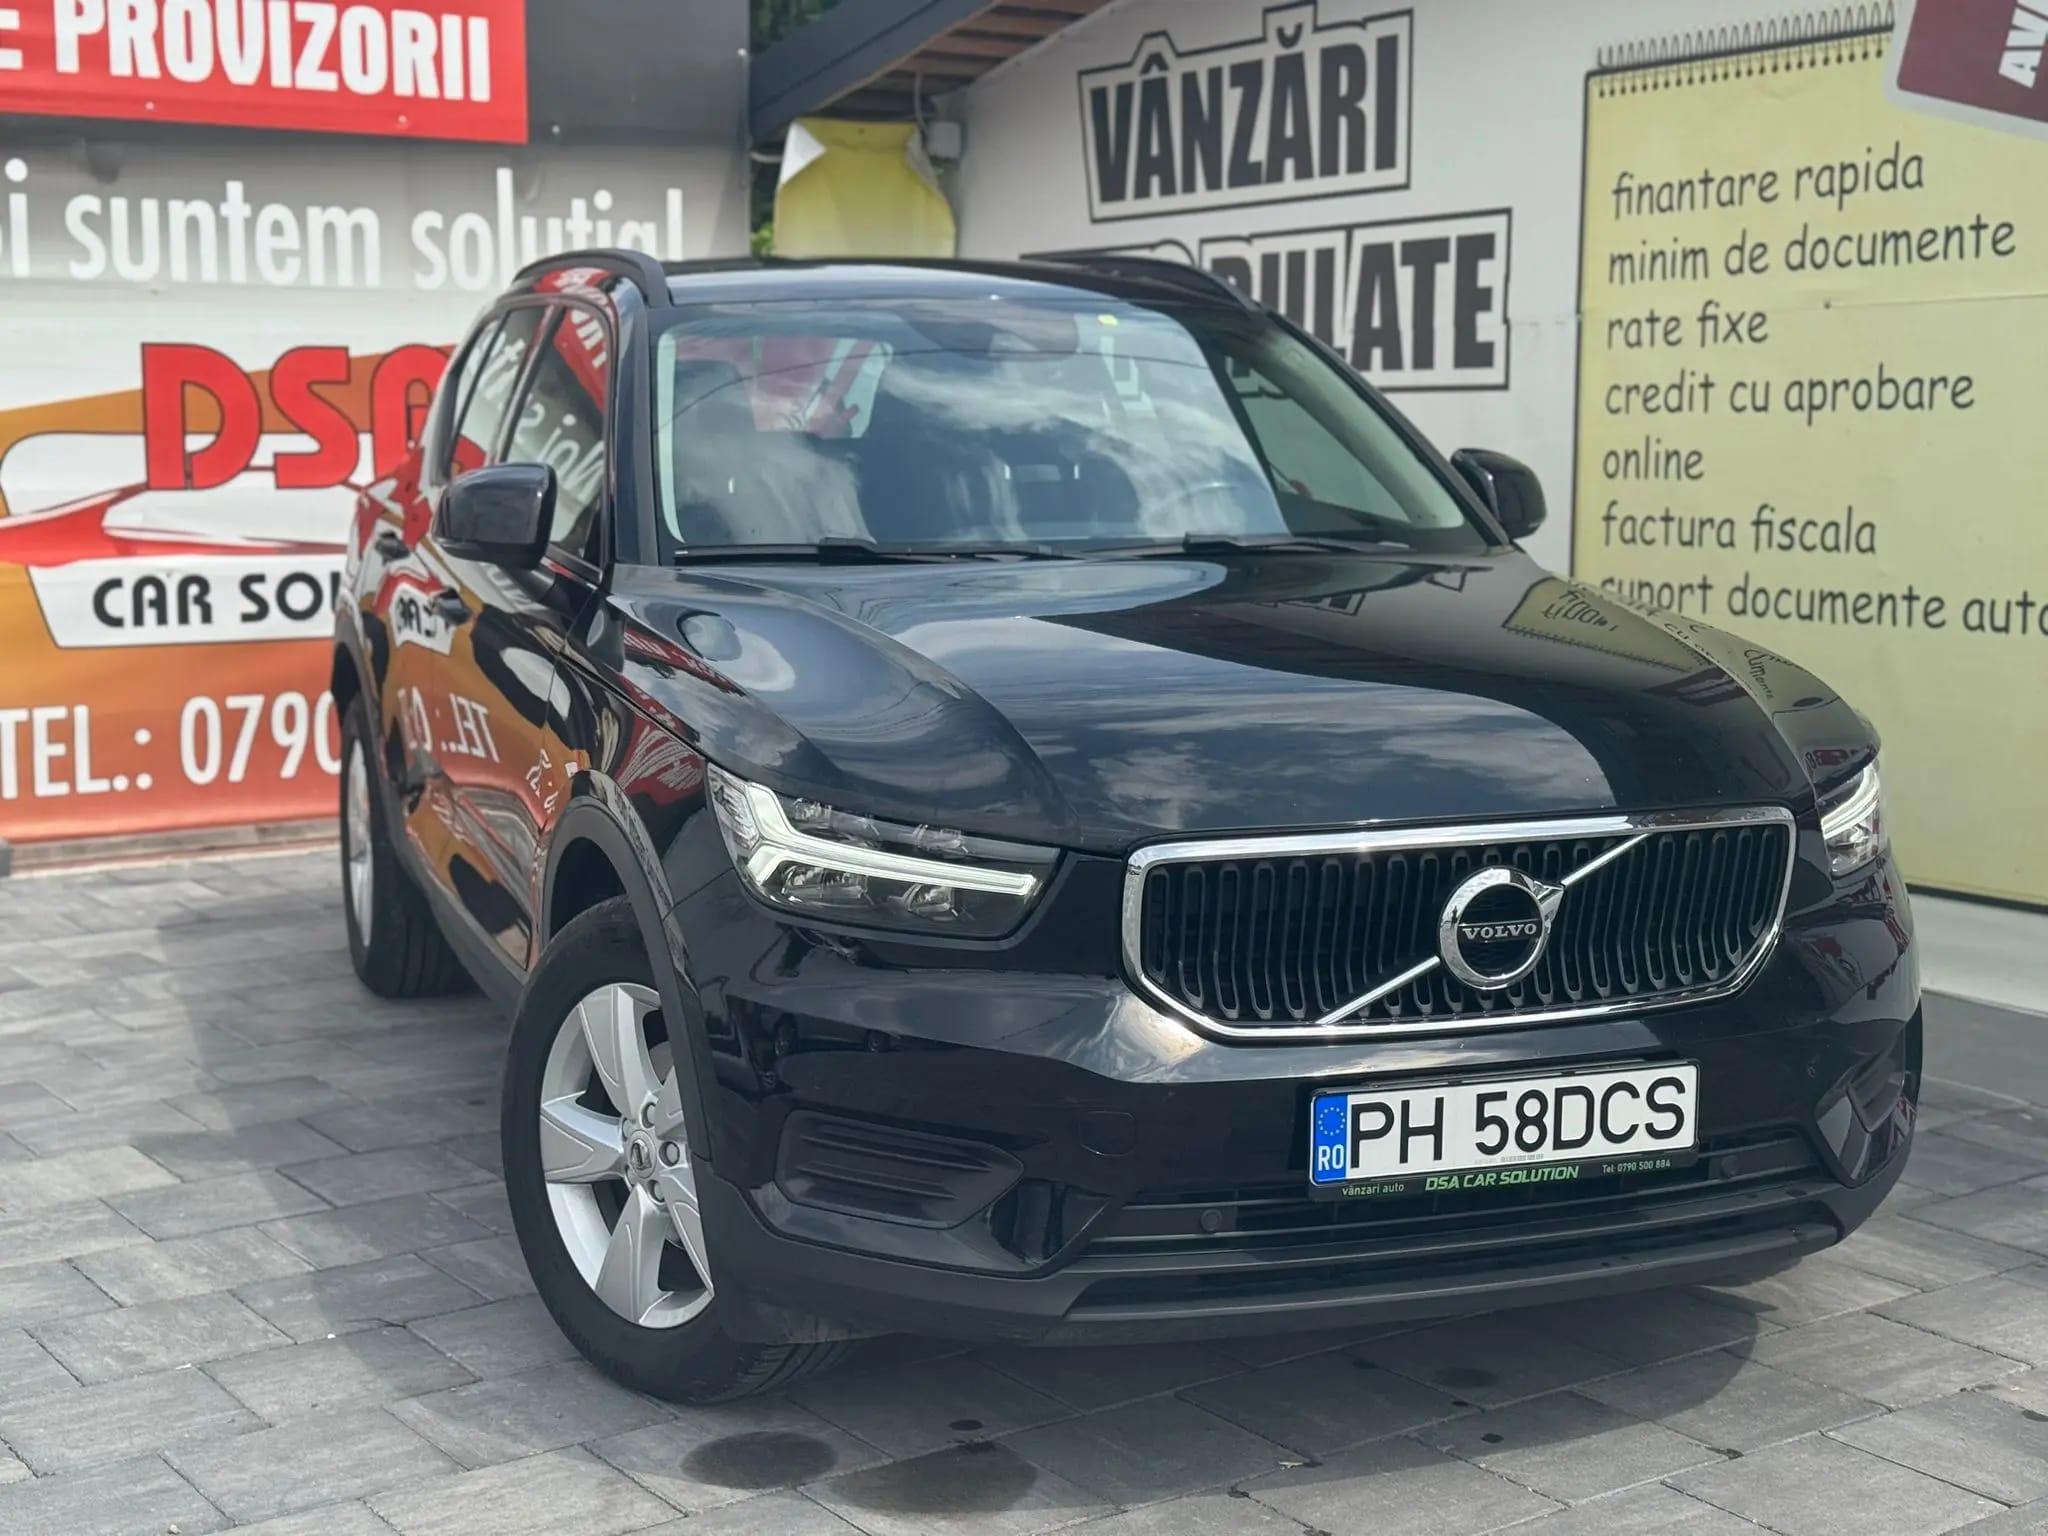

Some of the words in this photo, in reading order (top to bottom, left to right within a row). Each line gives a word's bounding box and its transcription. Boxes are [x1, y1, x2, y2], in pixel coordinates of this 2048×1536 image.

[54, 0, 491, 102] PROVIZORII
[1090, 24, 1399, 203] VÂNZĂRI
[1612, 170, 1779, 220] finantare
[1795, 141, 1924, 211] rapida
[65, 181, 381, 287] suntem
[1609, 238, 1709, 285] minim
[1724, 229, 1769, 276] de
[1785, 213, 2016, 271] documente
[1607, 309, 1682, 349] rate
[1697, 300, 1769, 347] fixe
[1605, 369, 1715, 414] credit
[1729, 381, 1770, 412] cu
[1784, 363, 1975, 426] aprobare
[1603, 435, 1704, 480] online
[1602, 500, 1735, 547] factura
[1751, 503, 1876, 554] fiscala
[93, 575, 213, 628] CAR
[1727, 571, 1947, 630] documente
[0, 704, 153, 799] TEL.:
[1462, 923, 1537, 940] VOLVO
[1350, 1097, 1444, 1169] PH
[1475, 1076, 1687, 1156] 58DCS
[1318, 1143, 1345, 1171] RO
[1425, 1175, 1460, 1192] DSA
[1463, 1172, 1496, 1188] CAR
[1499, 1165, 1580, 1185] SOLUTION
[1617, 1160, 1637, 1173] 0790
[1639, 1158, 1654, 1171] 500
[1382, 1183, 1404, 1194] auto
